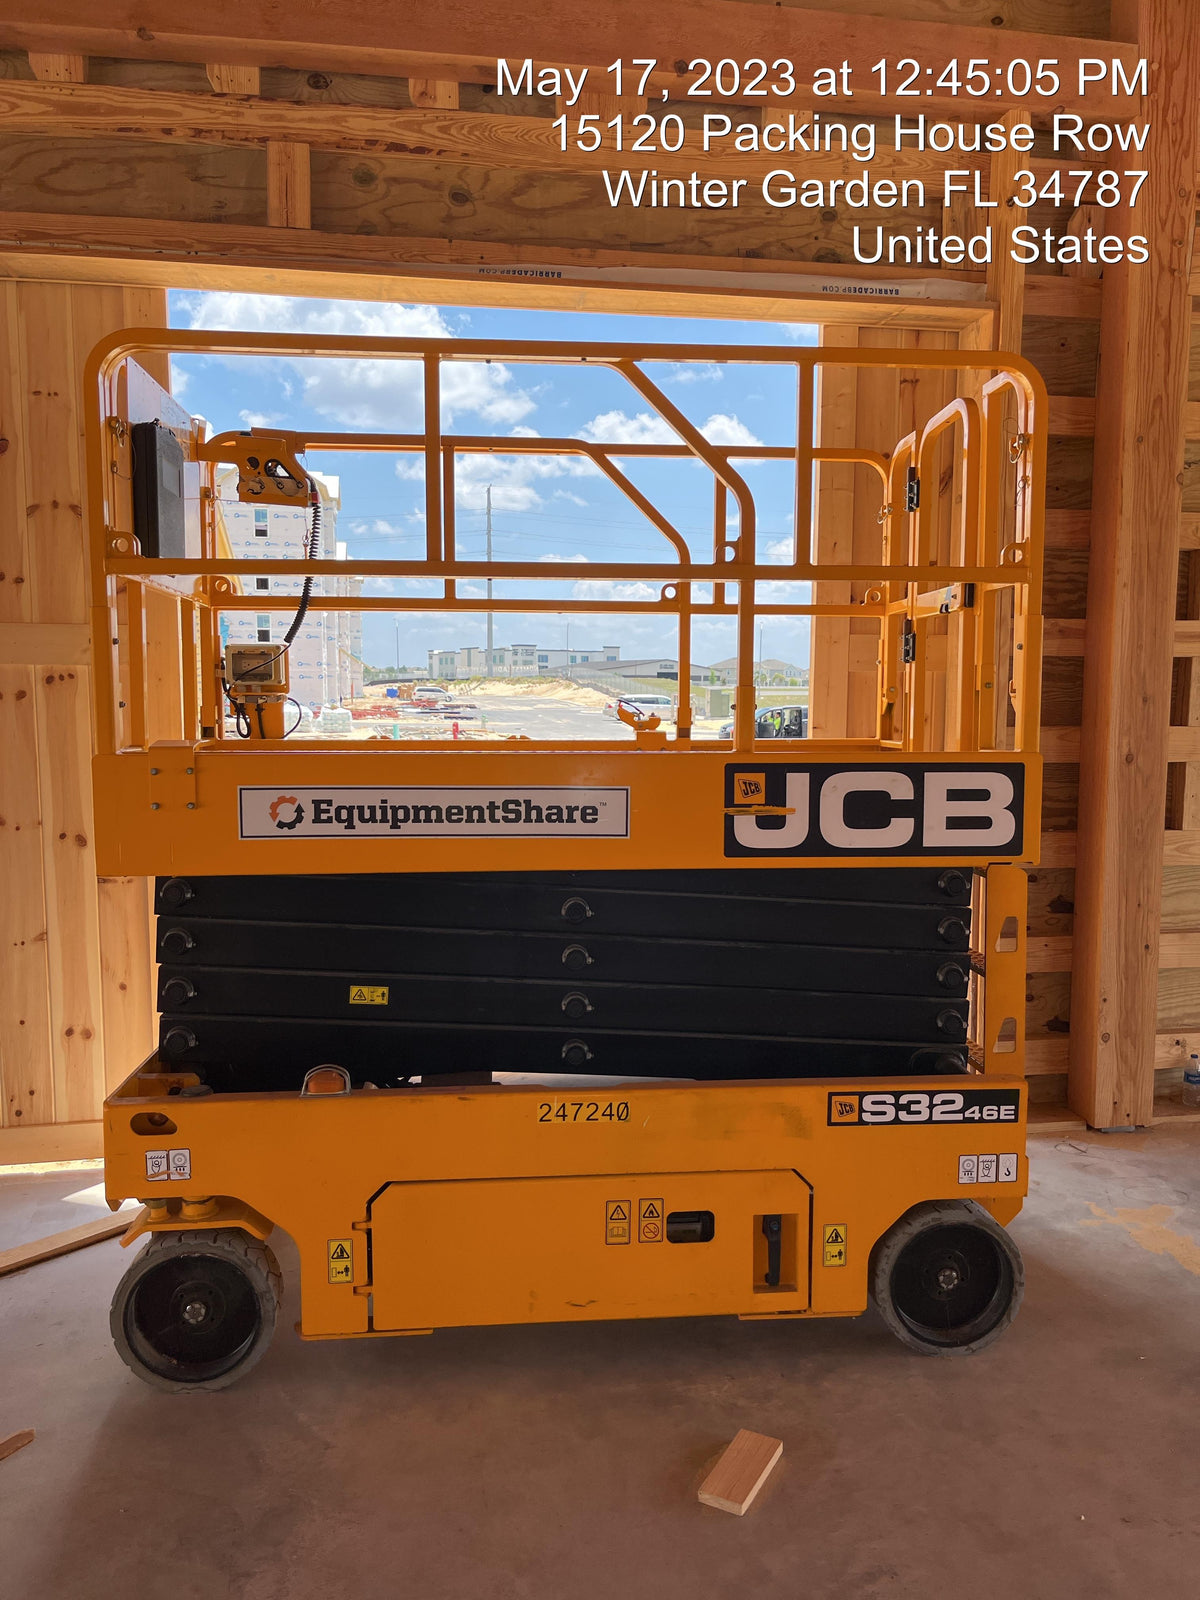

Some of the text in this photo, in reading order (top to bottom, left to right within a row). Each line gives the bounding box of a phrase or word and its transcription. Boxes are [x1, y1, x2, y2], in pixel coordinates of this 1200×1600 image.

[742, 780, 762, 797] JCB
[311, 798, 599, 830] EquipmentShare
[733, 771, 1016, 849] JCB
[539, 1101, 630, 1122] 247240
[837, 1102, 855, 1115] JCB
